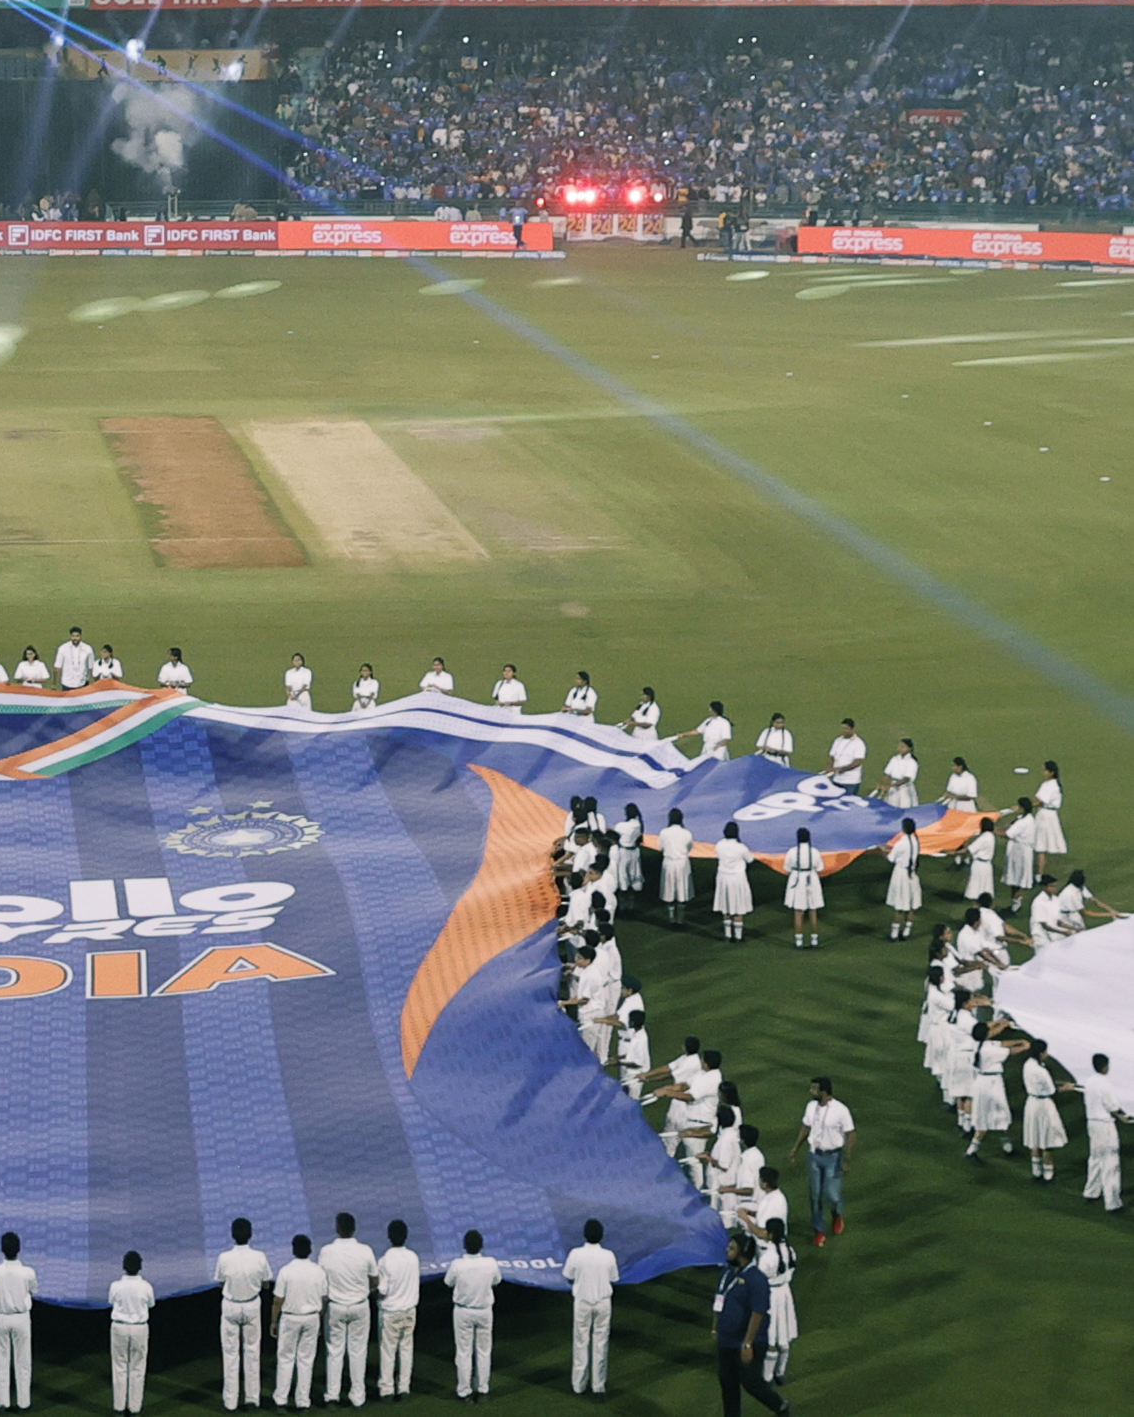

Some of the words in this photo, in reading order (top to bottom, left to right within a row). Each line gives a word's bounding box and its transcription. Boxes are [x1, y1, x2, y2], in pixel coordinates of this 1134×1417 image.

[31, 229, 62, 242] IDFC
[65, 229, 103, 242] FIRST
[106, 229, 140, 242] Bank
[167, 229, 198, 242] IDFC
[201, 229, 240, 242] FIRST
[242, 229, 276, 242] Bank
[312, 230, 382, 245] express
[449, 230, 517, 246] express
[832, 230, 852, 238] AIR
[854, 230, 884, 238] INDIA
[972, 234, 992, 242] AIR
[994, 234, 1023, 242] INDIA
[831, 237, 903, 253] express
[971, 241, 1043, 256] express
